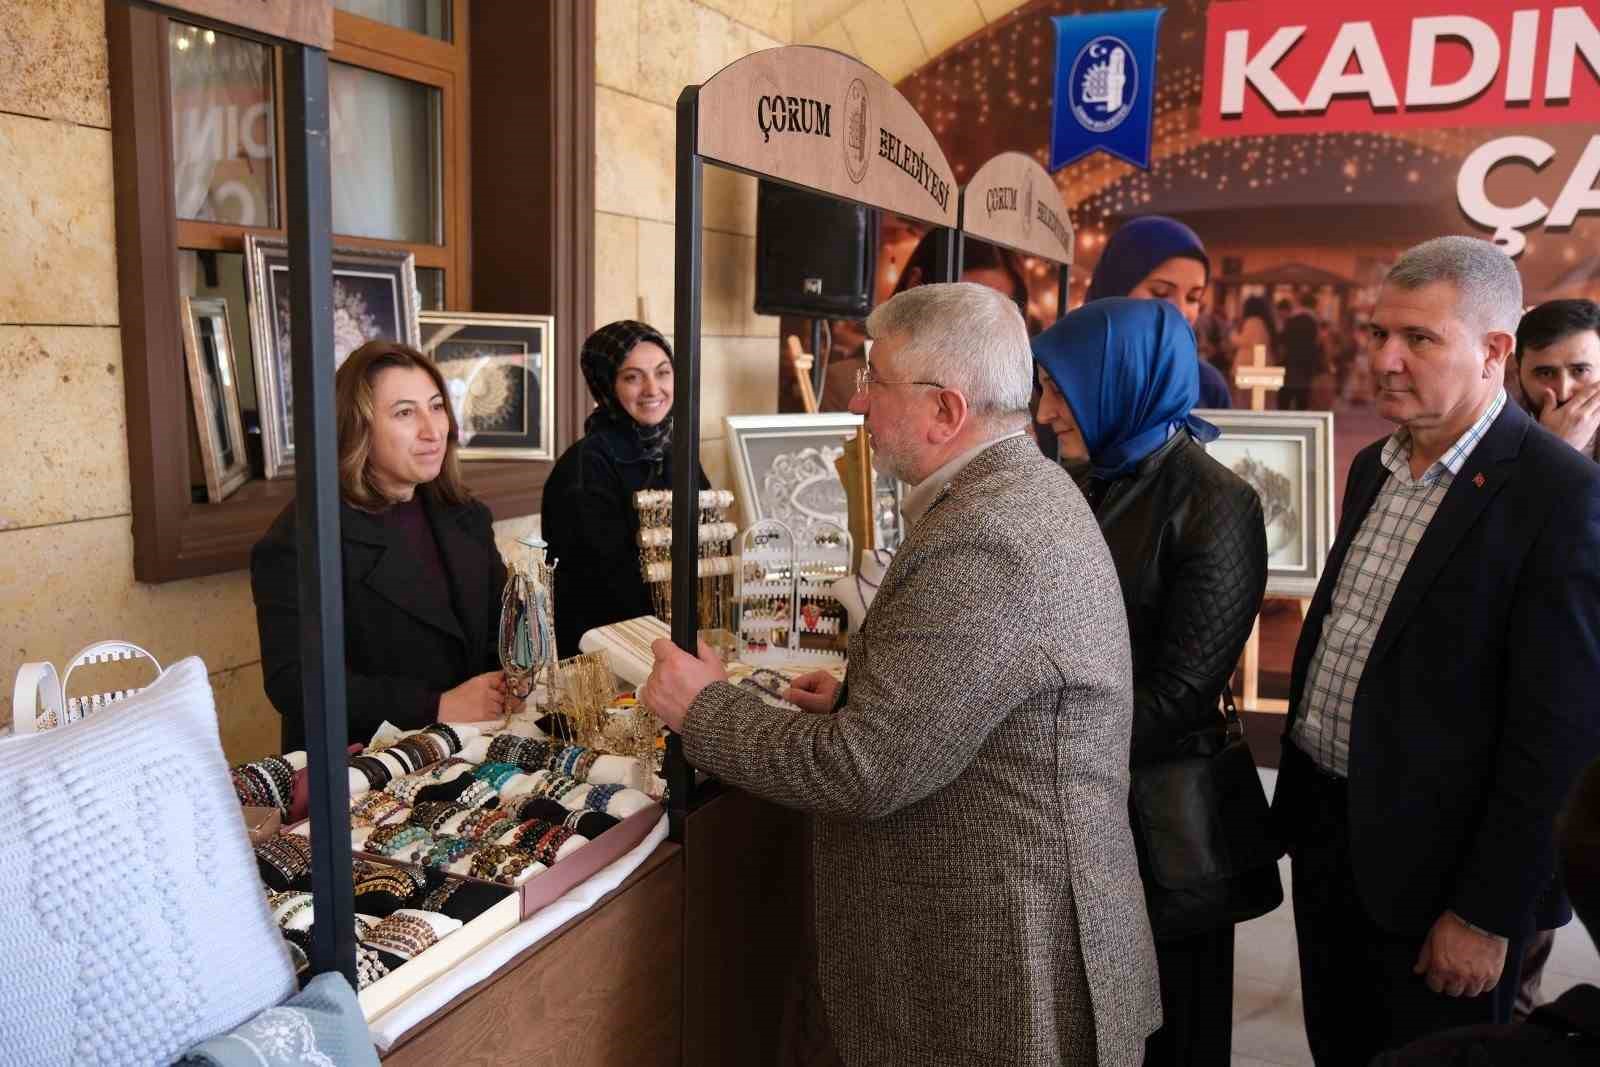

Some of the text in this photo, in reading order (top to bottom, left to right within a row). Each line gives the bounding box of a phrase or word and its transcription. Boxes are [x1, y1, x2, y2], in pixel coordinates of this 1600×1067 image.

[1219, 6, 1600, 116] KADIN
[757, 95, 950, 213] ÇORUM BELEDİYESİ
